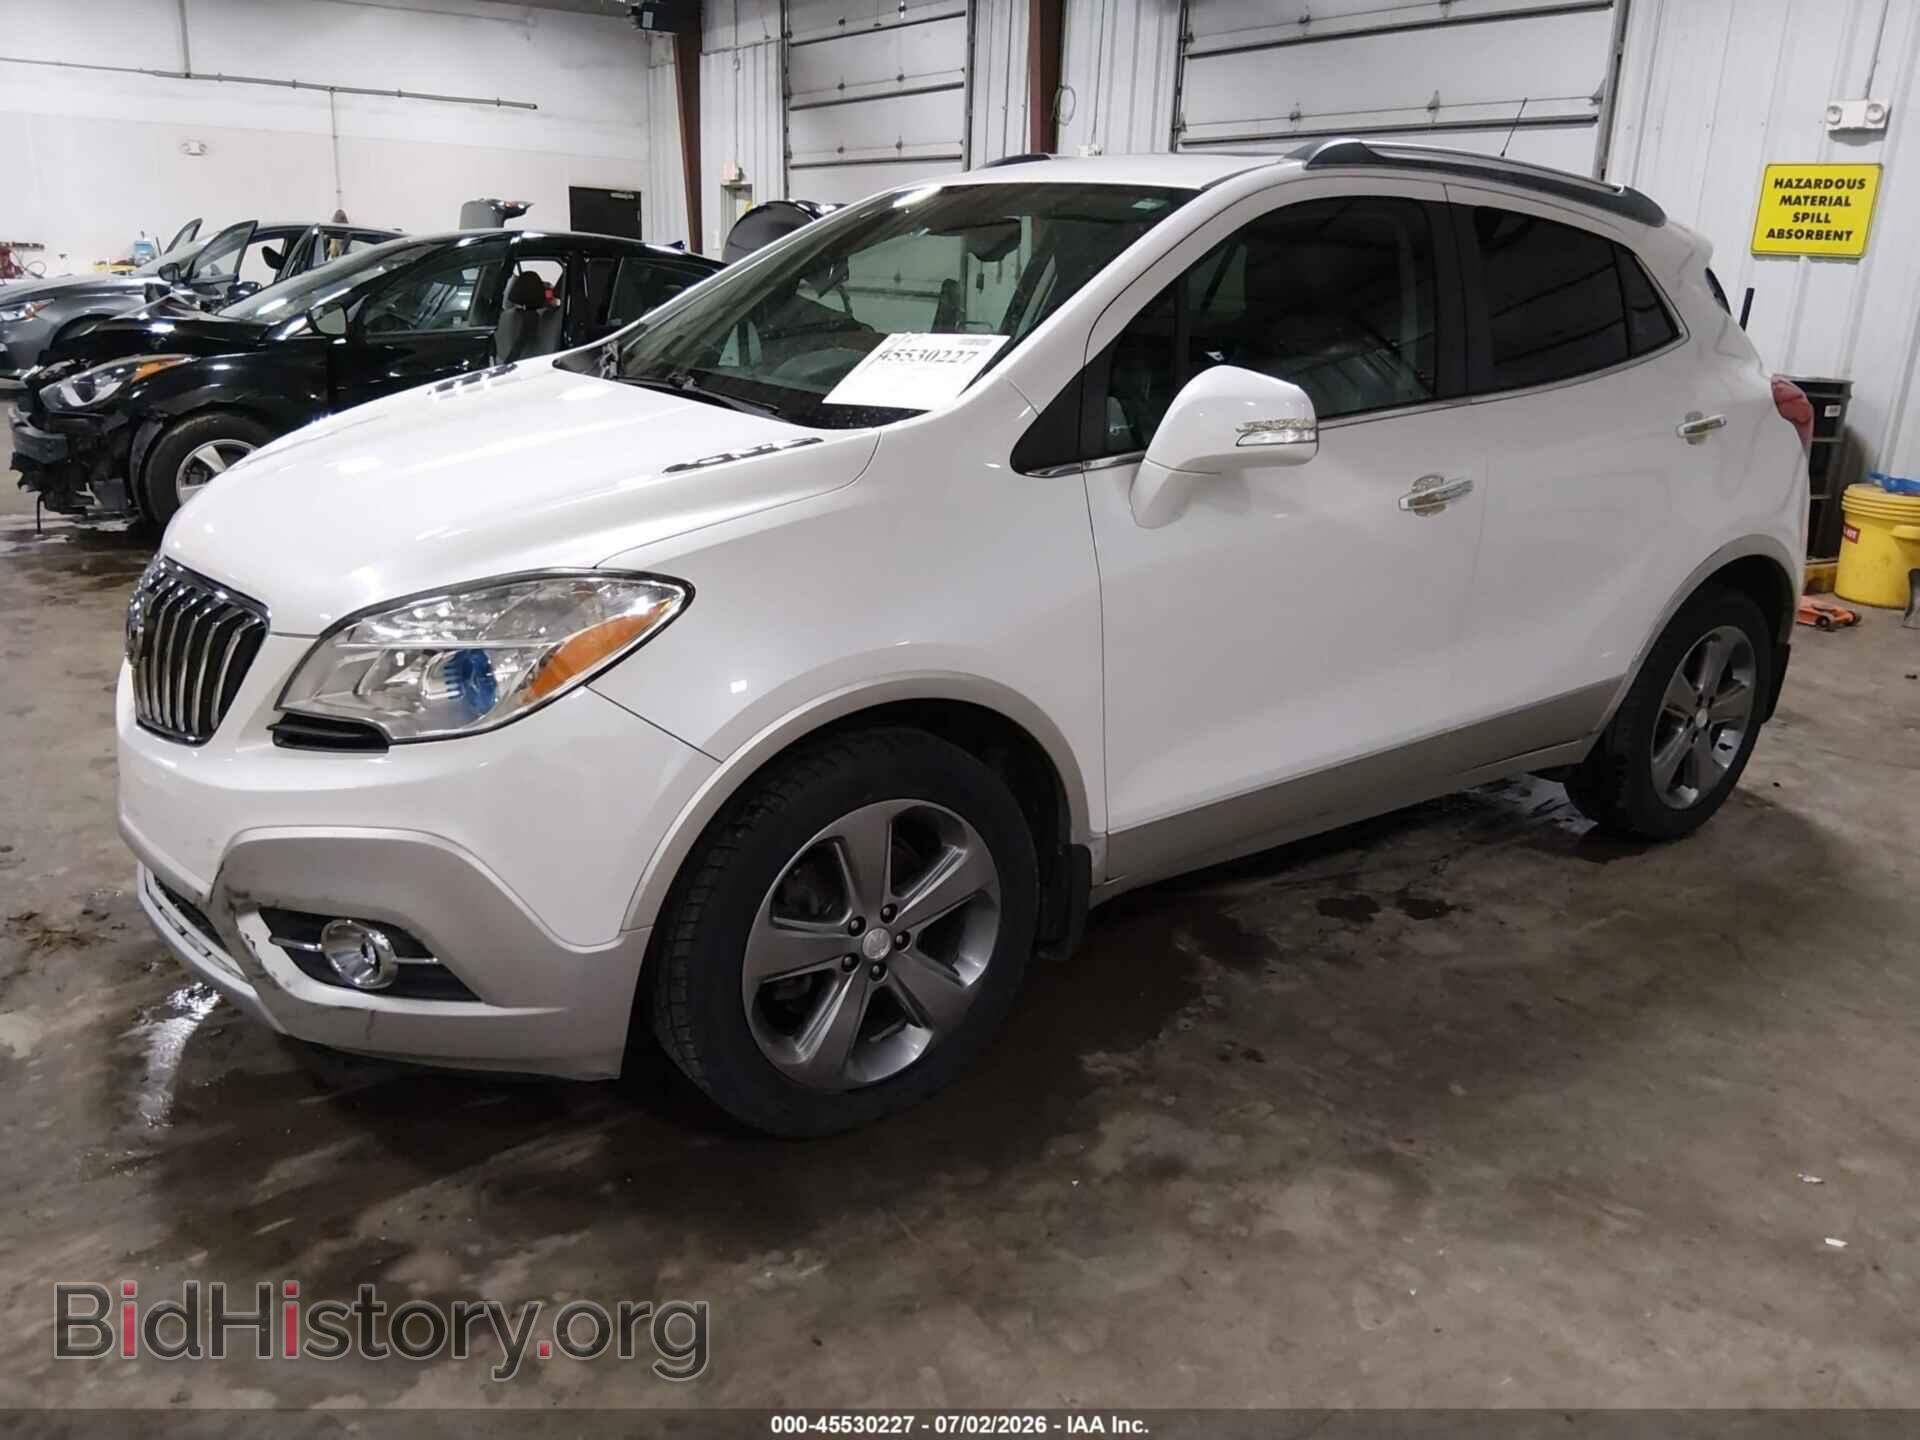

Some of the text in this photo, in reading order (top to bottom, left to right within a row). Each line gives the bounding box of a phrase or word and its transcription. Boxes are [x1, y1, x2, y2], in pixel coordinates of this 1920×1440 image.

[1773, 178, 1866, 190] HAZARDOUS
[1779, 195, 1852, 207] MATERIAL
[1791, 212, 1832, 224] SPILL
[1766, 228, 1853, 241] ABSORBENT
